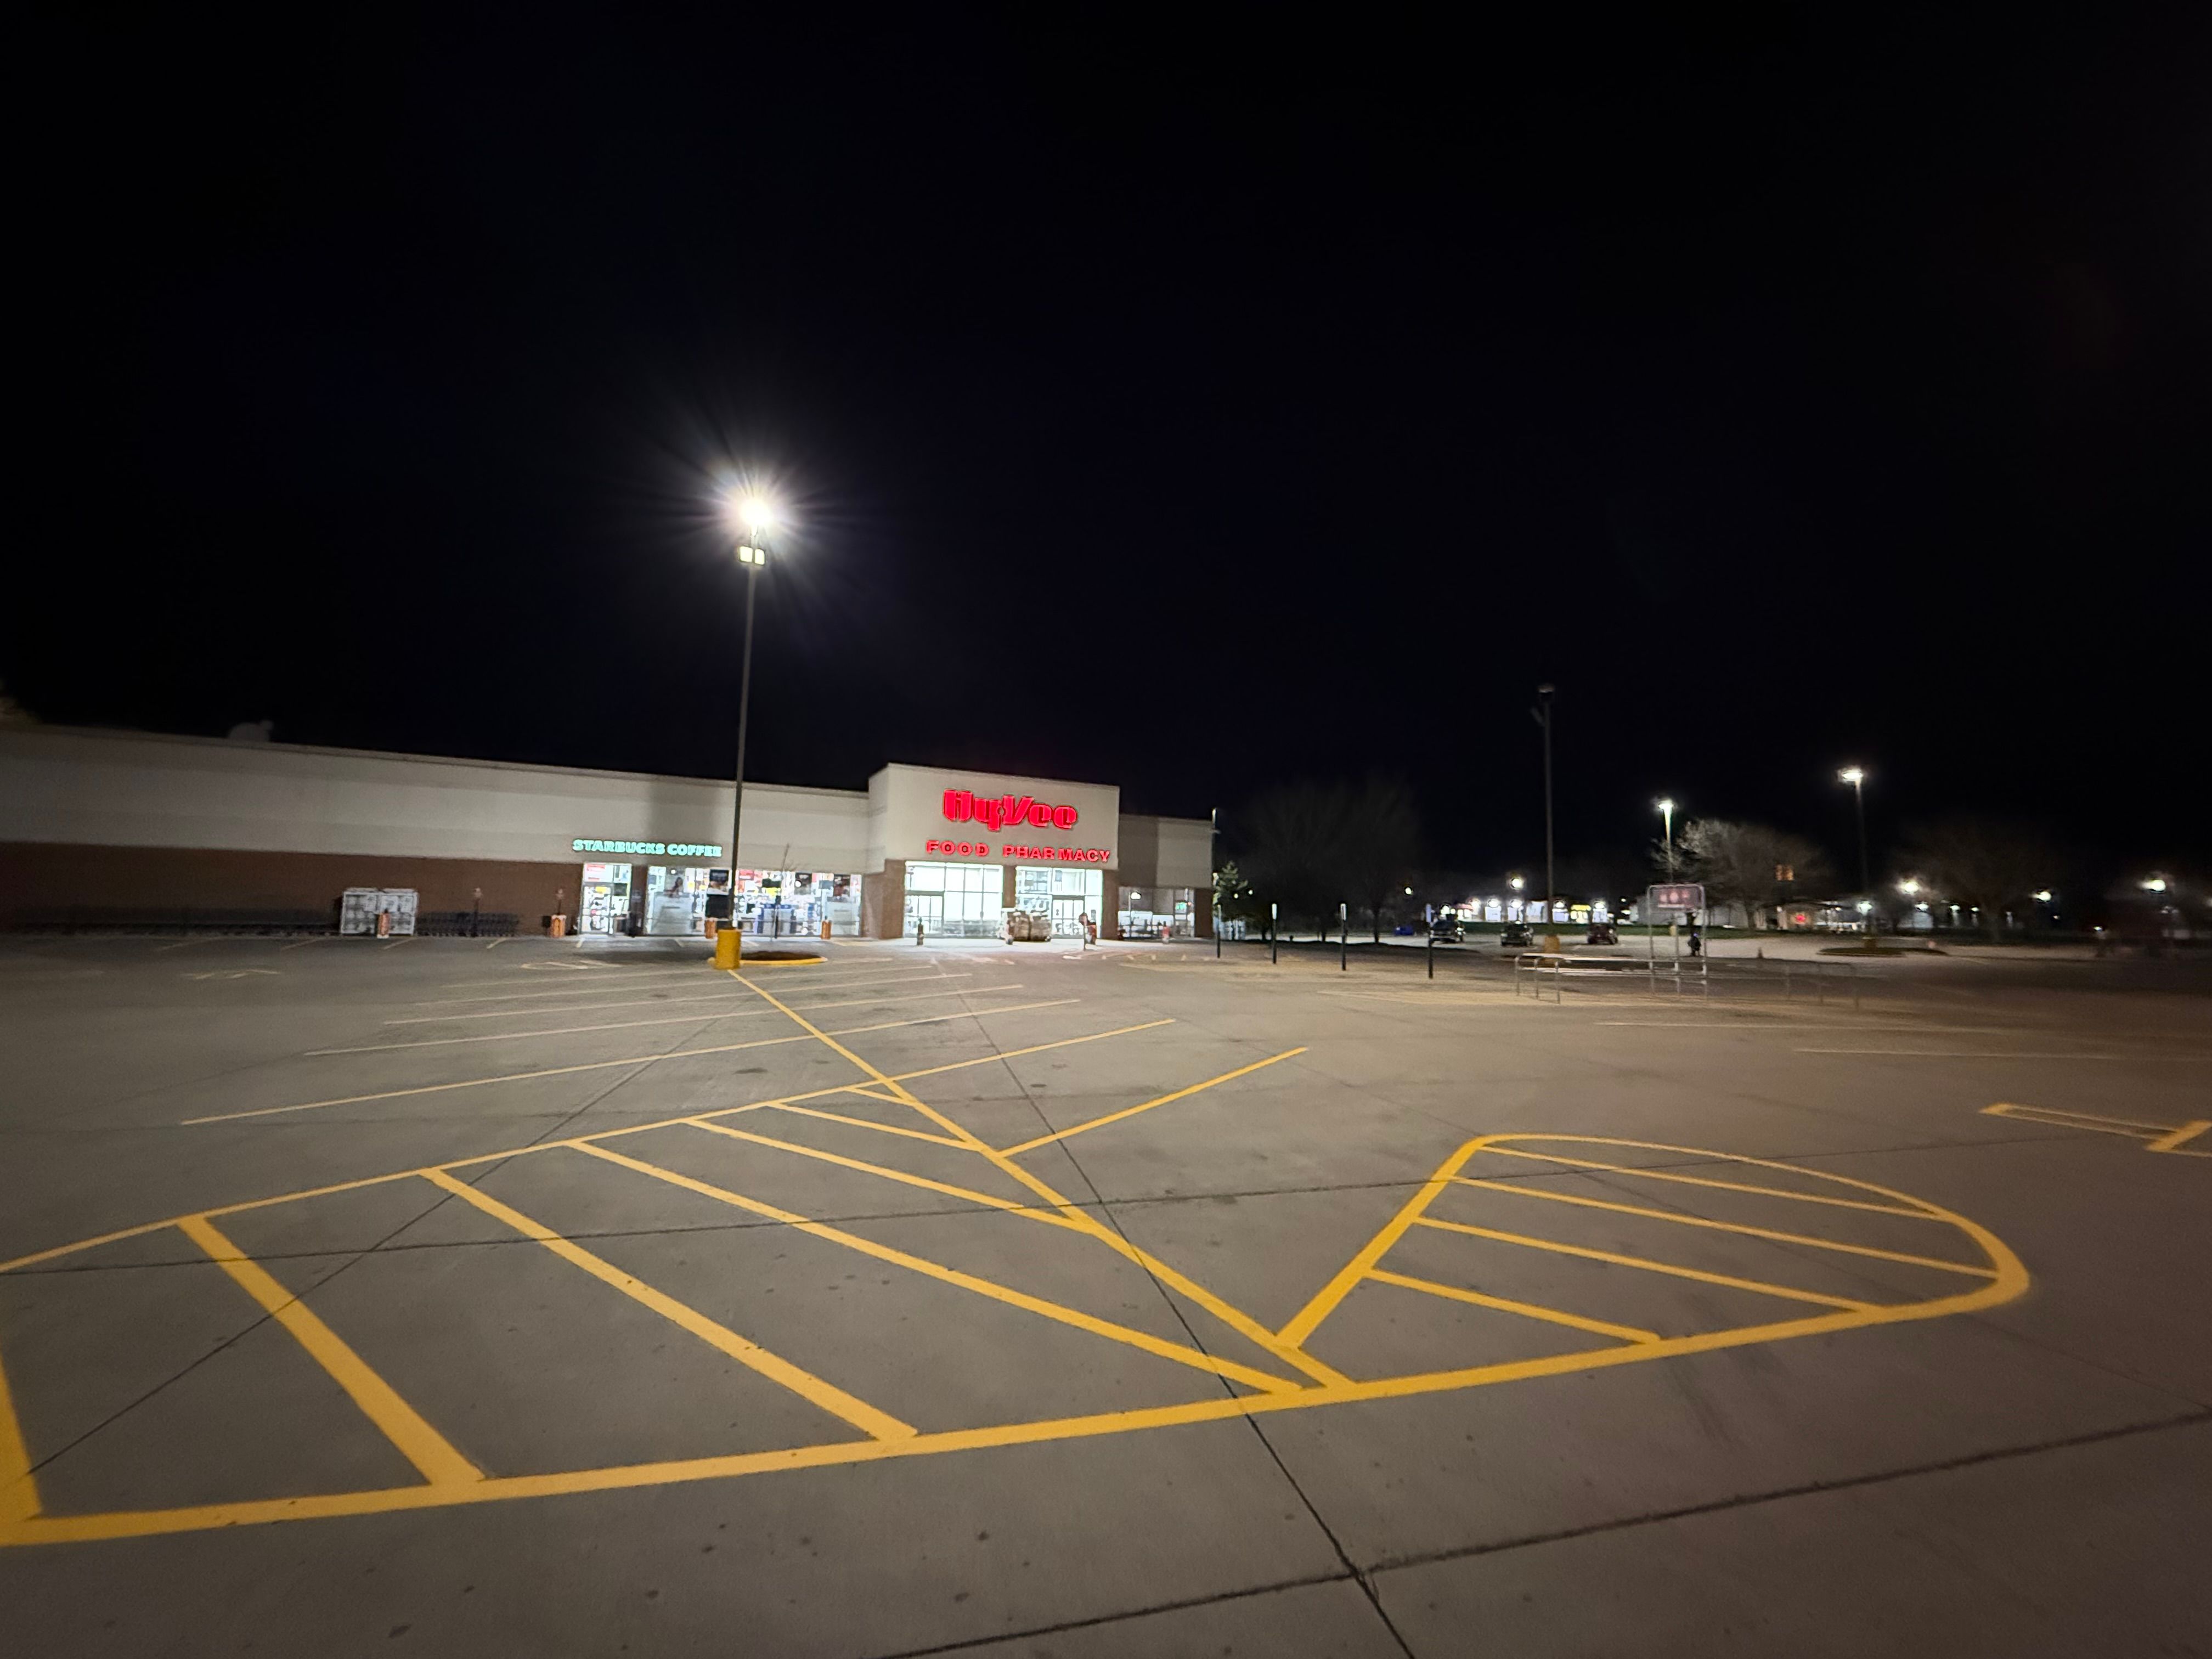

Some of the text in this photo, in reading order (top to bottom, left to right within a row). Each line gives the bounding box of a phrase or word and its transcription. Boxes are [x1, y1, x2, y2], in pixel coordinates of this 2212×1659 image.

[572, 839, 722, 856] STARBUCKS COFFEE
[926, 840, 1110, 862] FOOD PHARMACY
